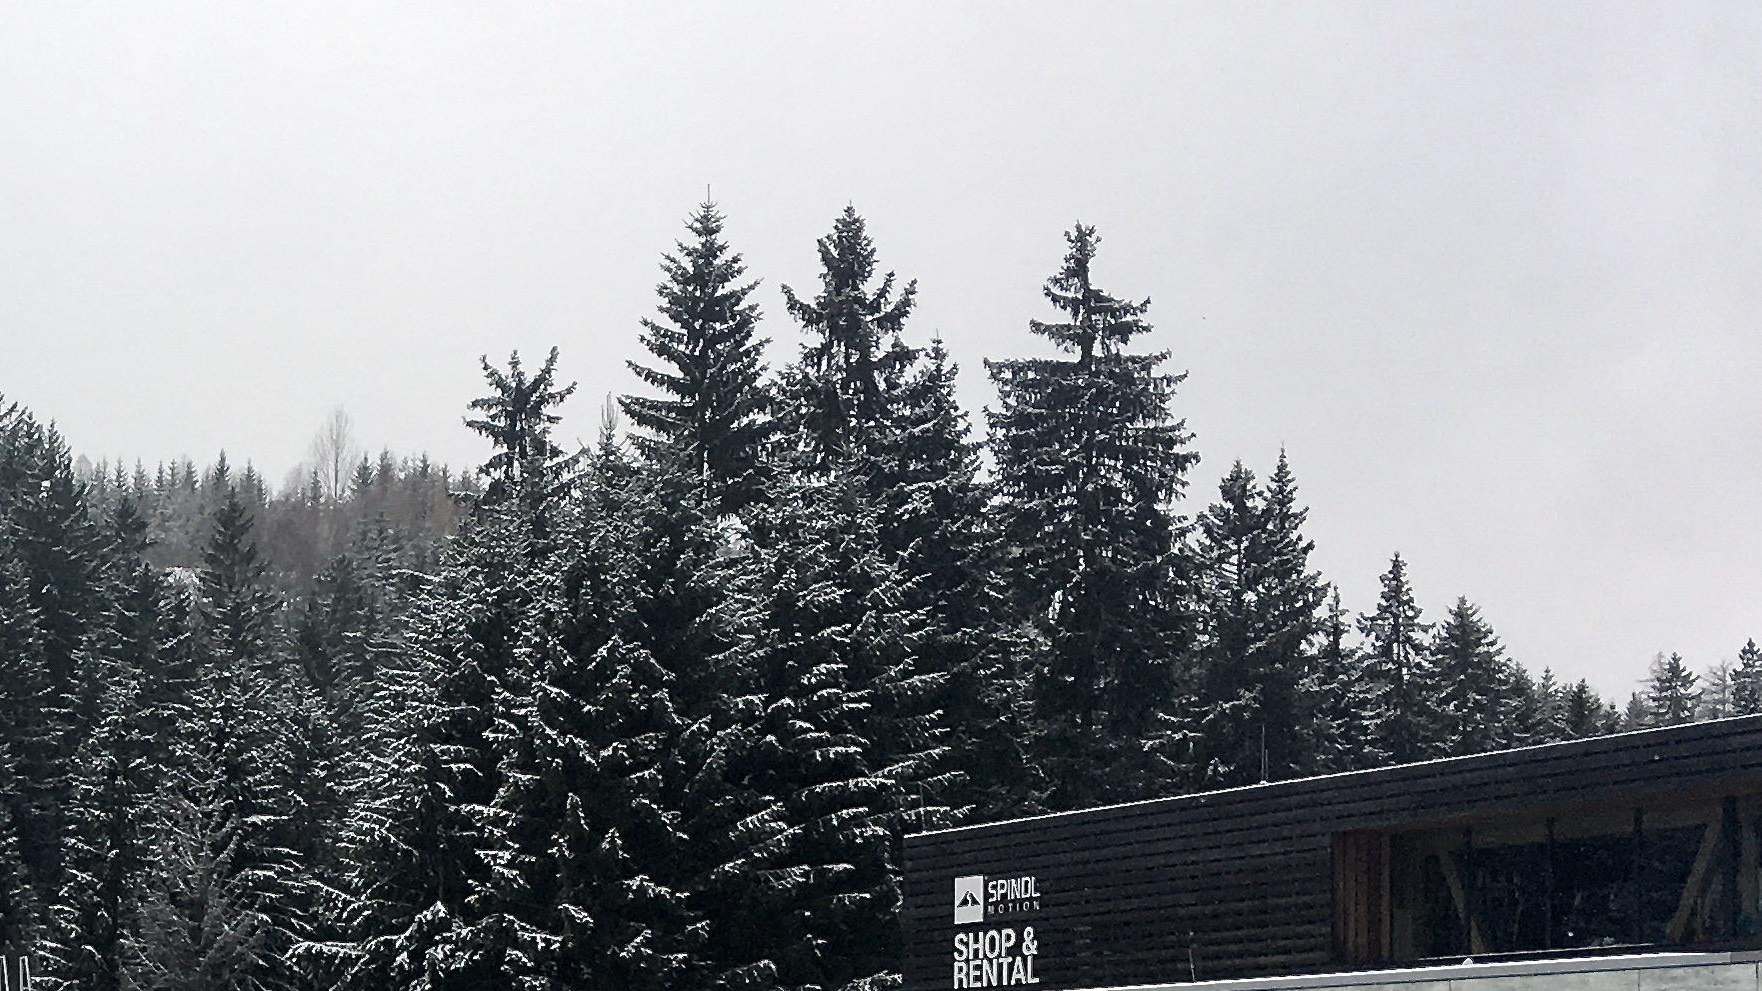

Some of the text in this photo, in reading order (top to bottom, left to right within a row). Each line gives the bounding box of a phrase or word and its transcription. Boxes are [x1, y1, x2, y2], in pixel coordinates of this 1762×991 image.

[988, 876, 1041, 902] SPINDL
[988, 901, 1040, 914] MOTION
[954, 926, 1038, 961] SHOP &
[954, 955, 1040, 989] RENTAL
